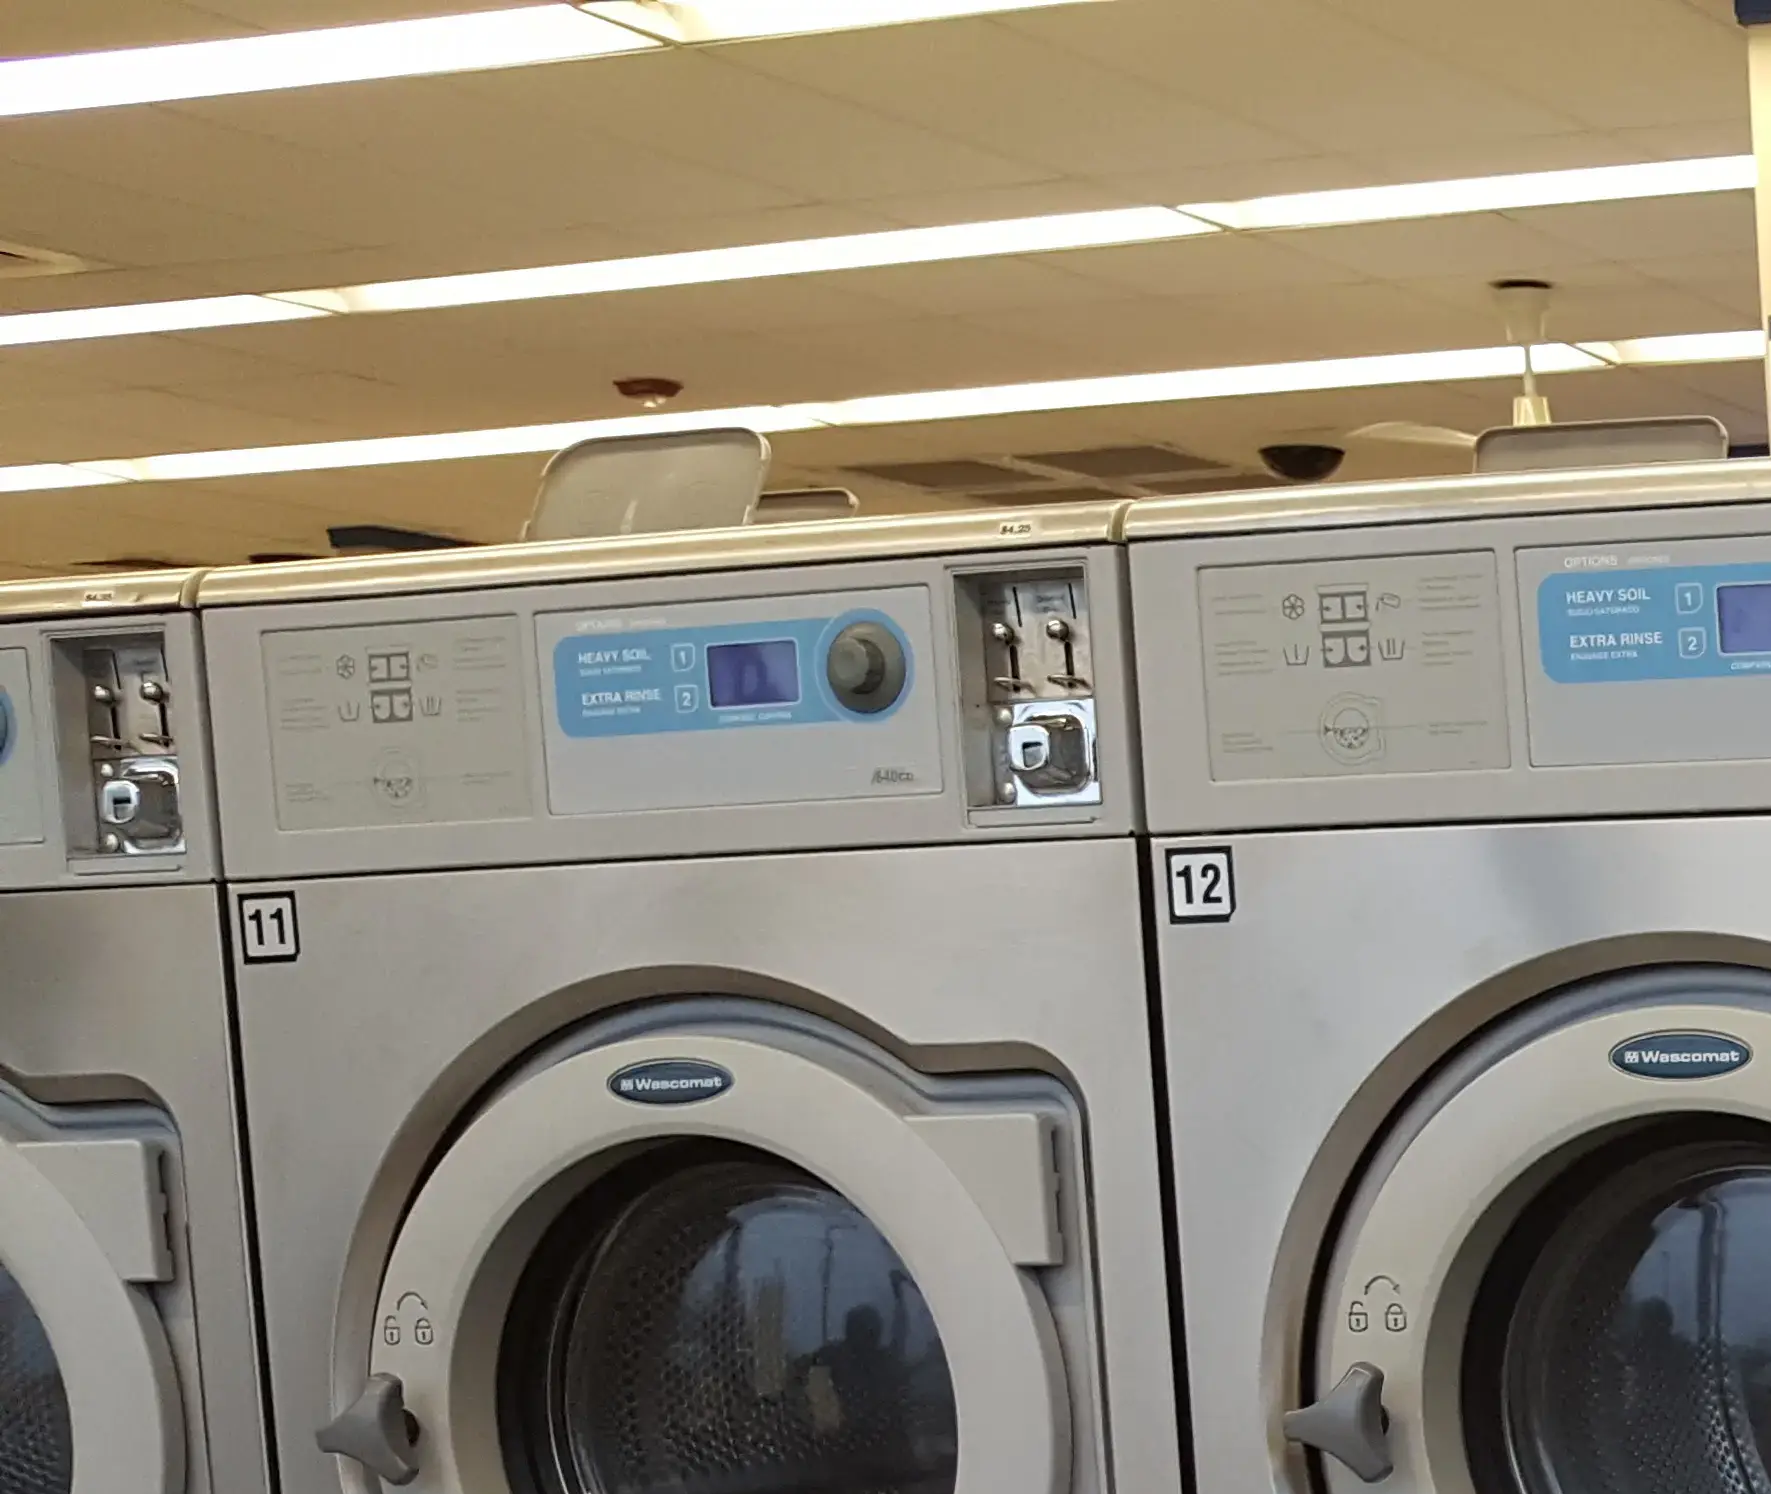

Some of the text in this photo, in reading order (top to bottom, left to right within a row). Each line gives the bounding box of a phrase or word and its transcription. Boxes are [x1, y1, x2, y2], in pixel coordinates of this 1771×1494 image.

[1564, 555, 1617, 568] OPTIONS
[1566, 588, 1693, 607] HEAVY SOIL 1
[1570, 631, 1698, 651] EXTRA RINSE 2
[577, 648, 687, 665] HEAVY SOIL 1
[581, 688, 692, 707] EXTRA RINSE 2
[1175, 863, 1222, 905] 12
[247, 907, 287, 947] 11
[1641, 1047, 1740, 1066] Wascomat
[635, 1073, 722, 1092] Wascomat
